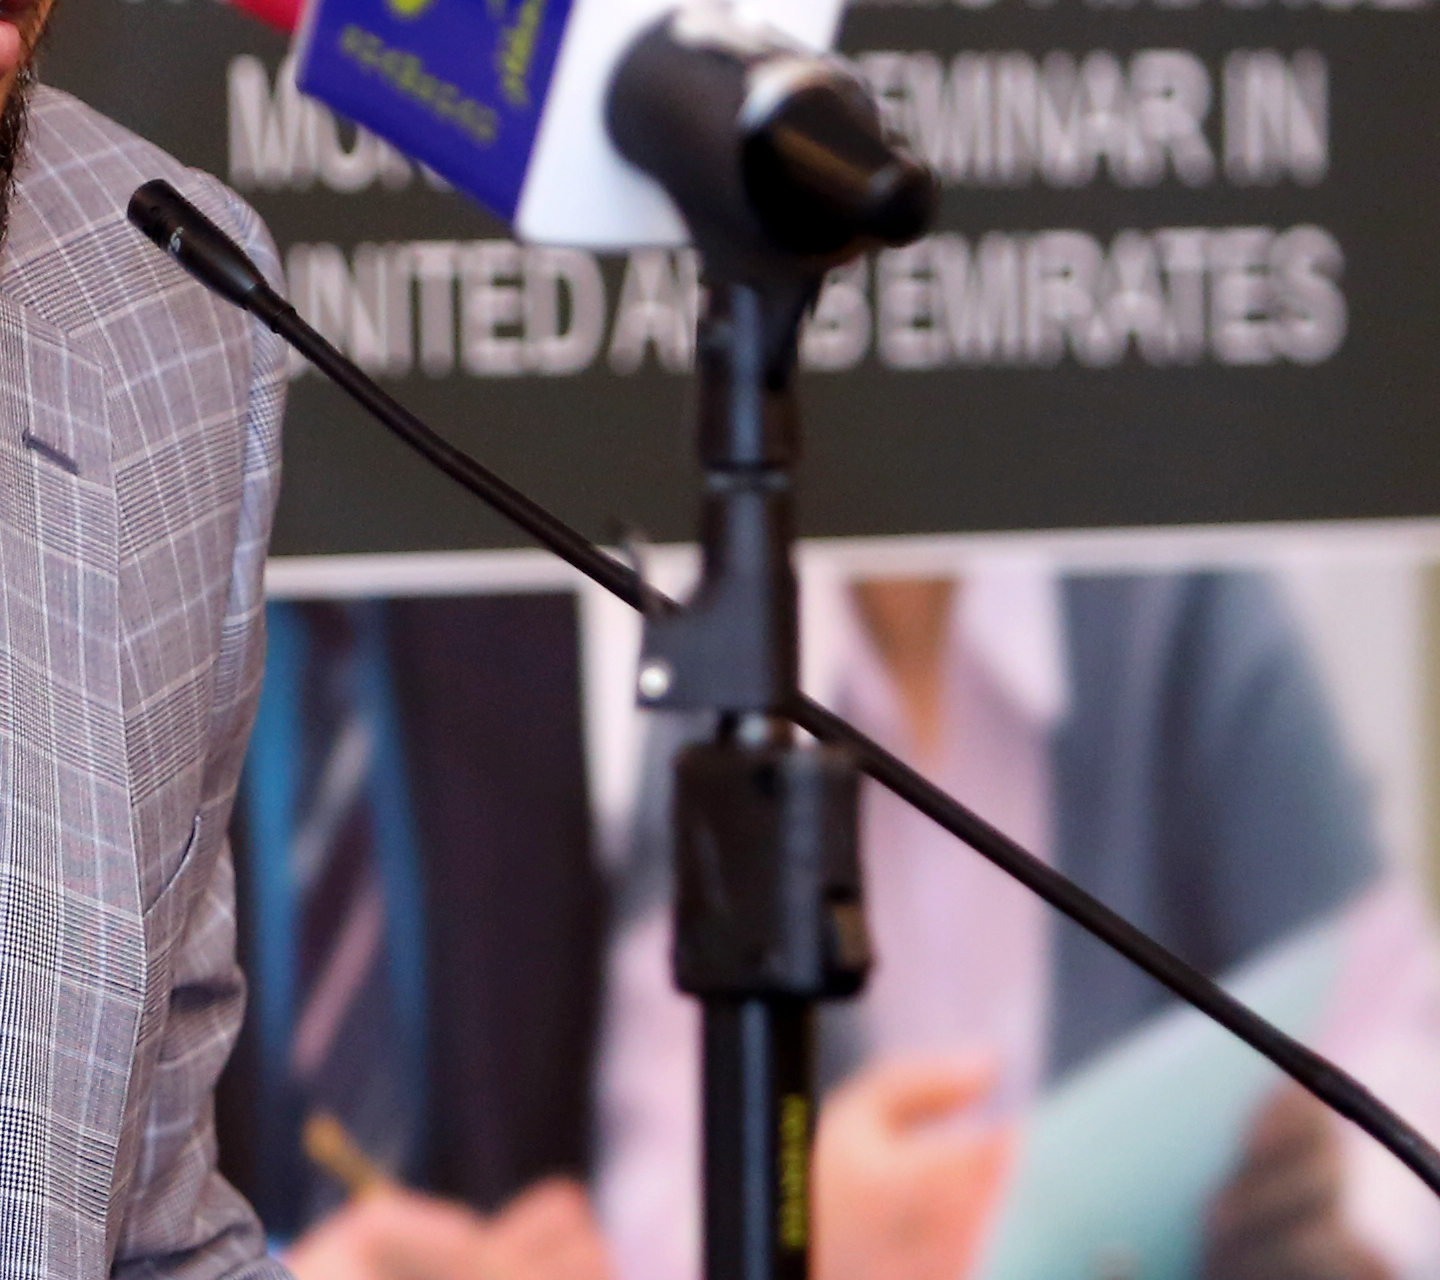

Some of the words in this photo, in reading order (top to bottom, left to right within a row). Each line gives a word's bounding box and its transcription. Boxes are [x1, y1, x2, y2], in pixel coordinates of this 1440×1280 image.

[856, 48, 1216, 188] EMINAR
[1224, 48, 1330, 188] IN
[283, 238, 609, 378] NITED
[873, 223, 1350, 372] EMIRATES
